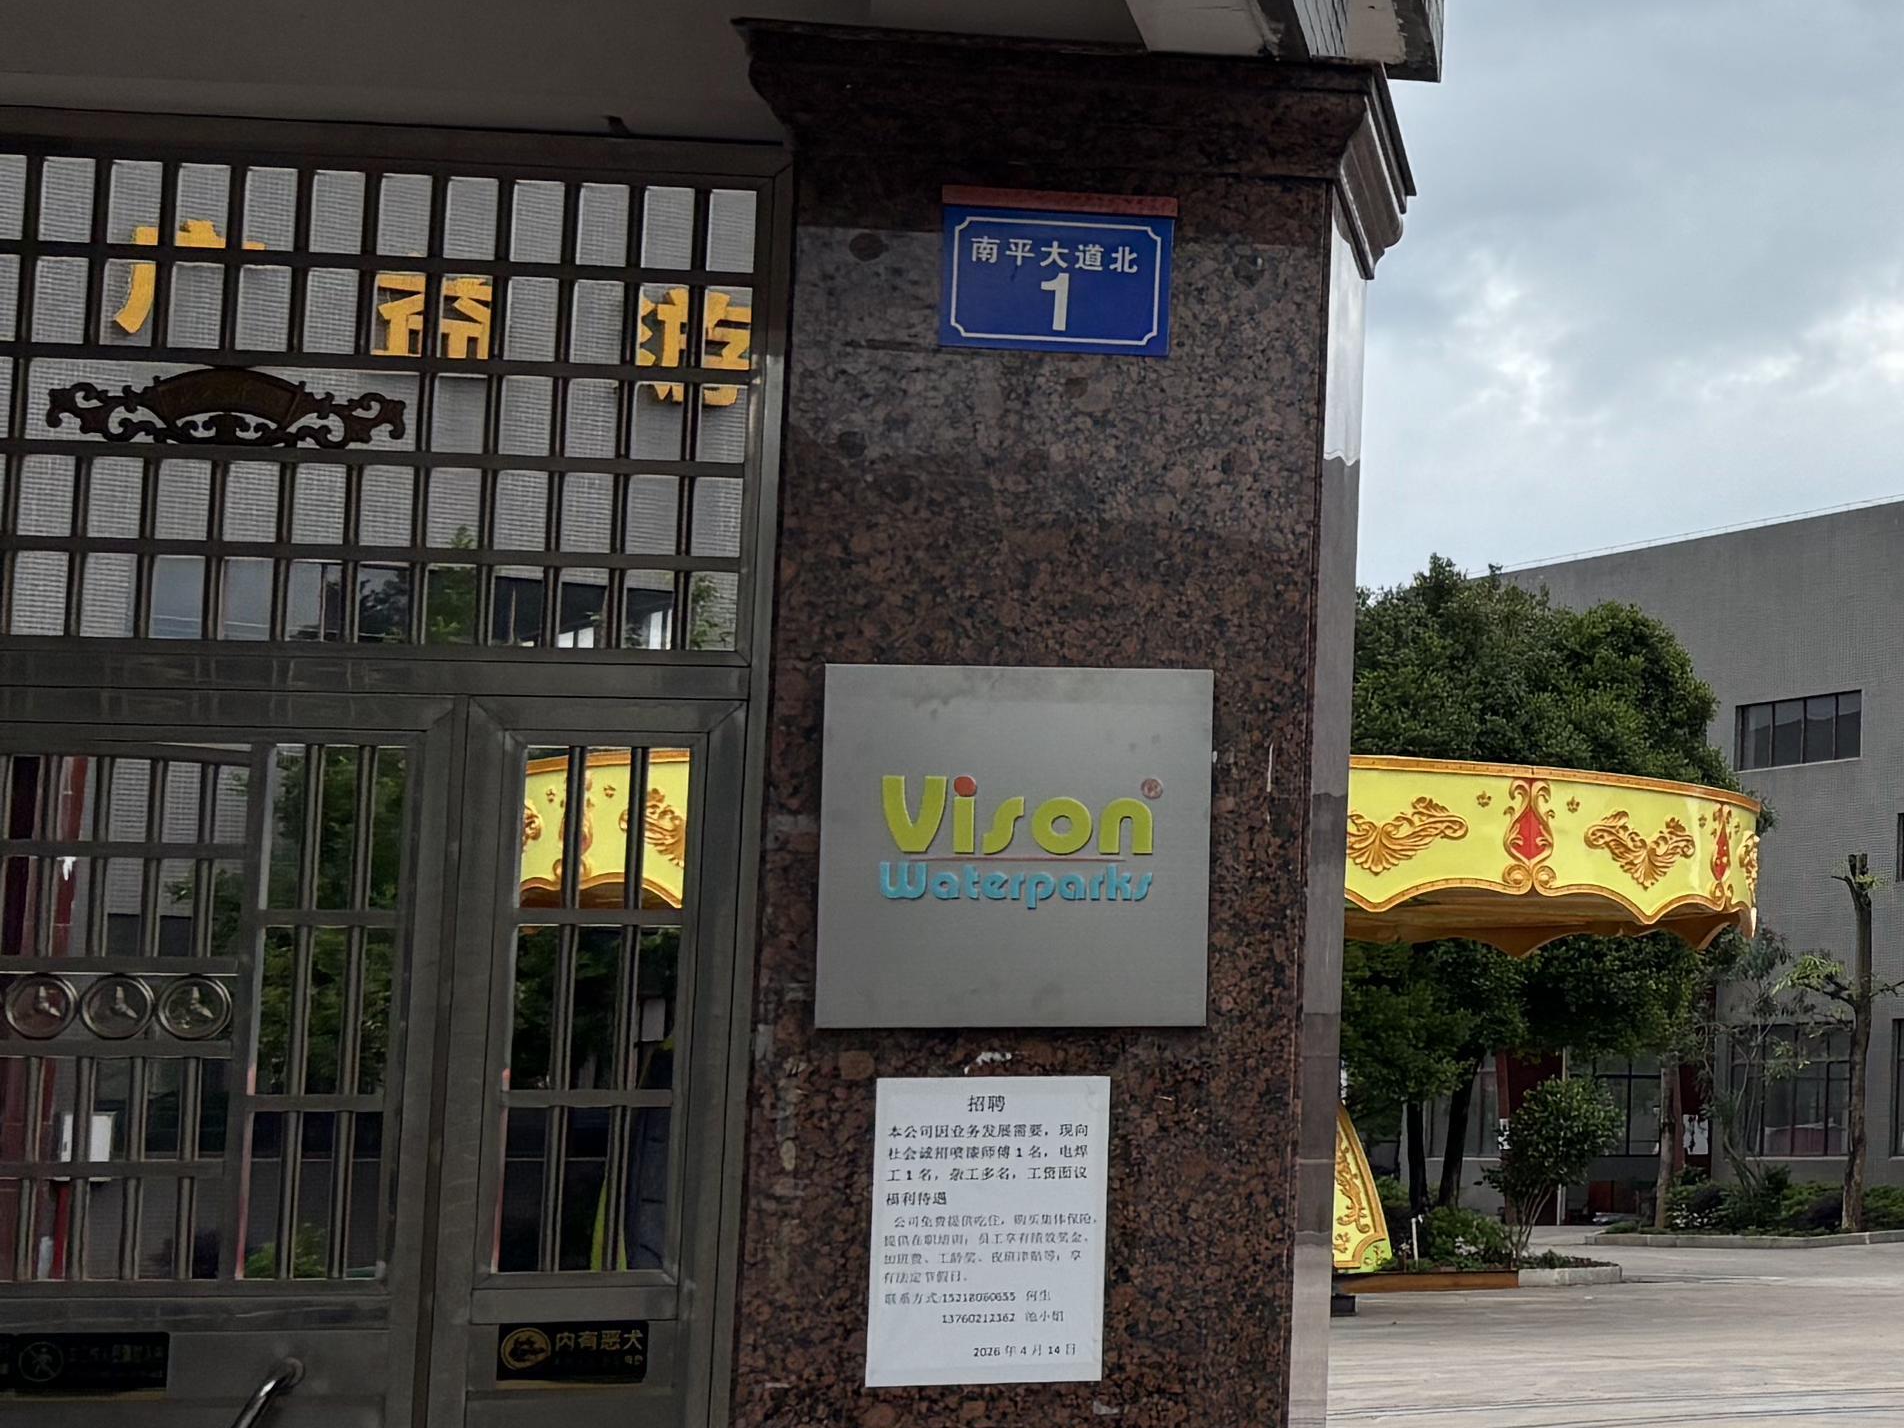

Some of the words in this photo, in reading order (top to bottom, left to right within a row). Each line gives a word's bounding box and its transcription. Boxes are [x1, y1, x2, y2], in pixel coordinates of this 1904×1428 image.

[970, 235, 1139, 274] 南平大道北
[1040, 272, 1070, 332] 1
[879, 861, 1153, 910] Waterparks
[967, 1094, 1006, 1113] 招聘
[555, 1329, 644, 1352] 内有恶犬
